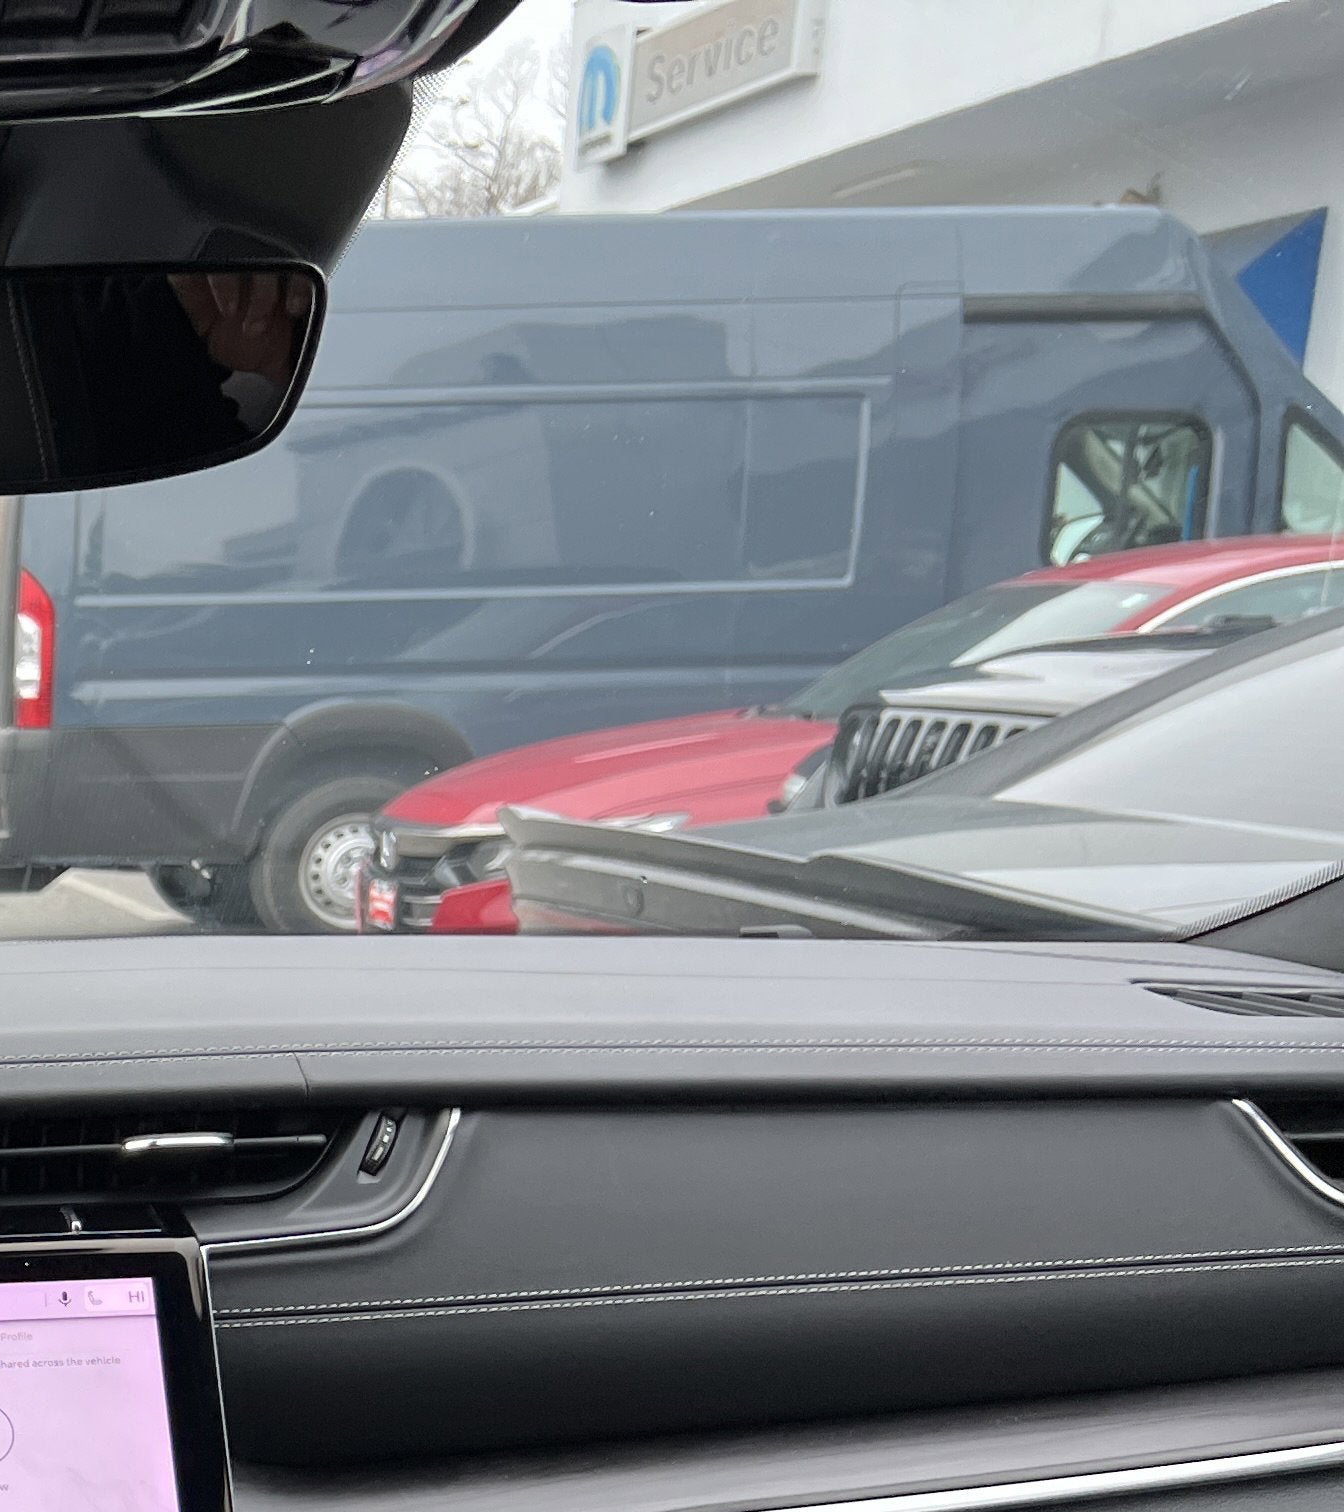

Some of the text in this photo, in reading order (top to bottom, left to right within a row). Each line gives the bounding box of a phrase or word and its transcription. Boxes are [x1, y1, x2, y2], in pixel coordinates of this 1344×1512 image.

[646, 18, 779, 103] Service
[128, 1290, 146, 1304] HI
[0, 1331, 34, 1342] Profile
[32, 1359, 64, 1368] across
[66, 1357, 83, 1366] the
[85, 1355, 121, 1366] vehicle
